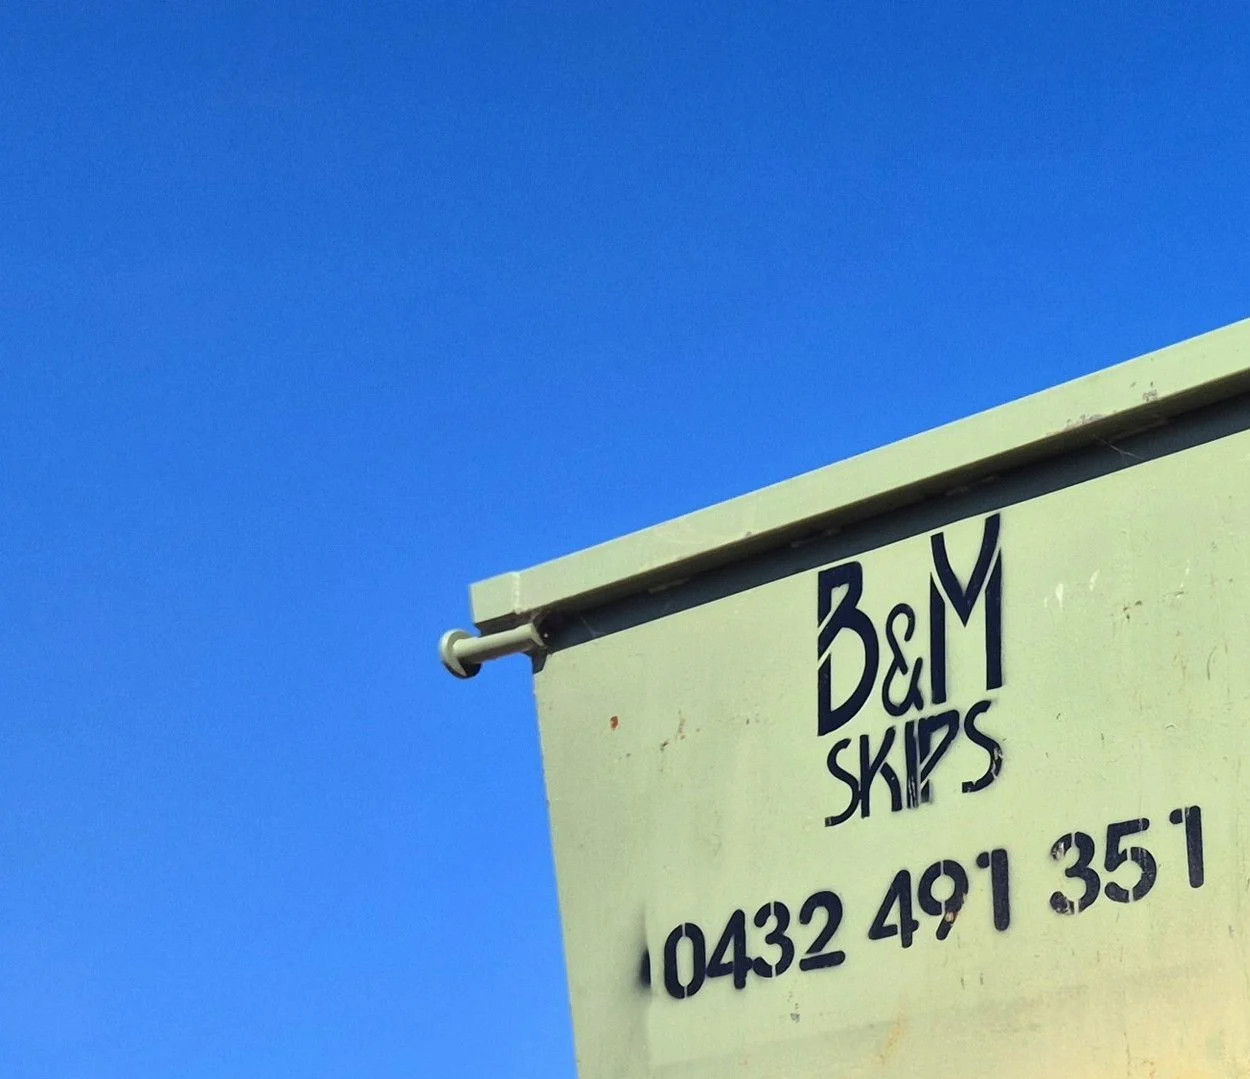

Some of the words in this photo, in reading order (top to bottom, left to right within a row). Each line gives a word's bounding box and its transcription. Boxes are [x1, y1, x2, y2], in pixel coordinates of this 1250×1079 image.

[817, 511, 1003, 737] B&M
[825, 700, 1002, 828] SKIPS
[663, 890, 846, 1000] 0432
[867, 848, 1011, 949] 491
[1050, 806, 1205, 914] 351
